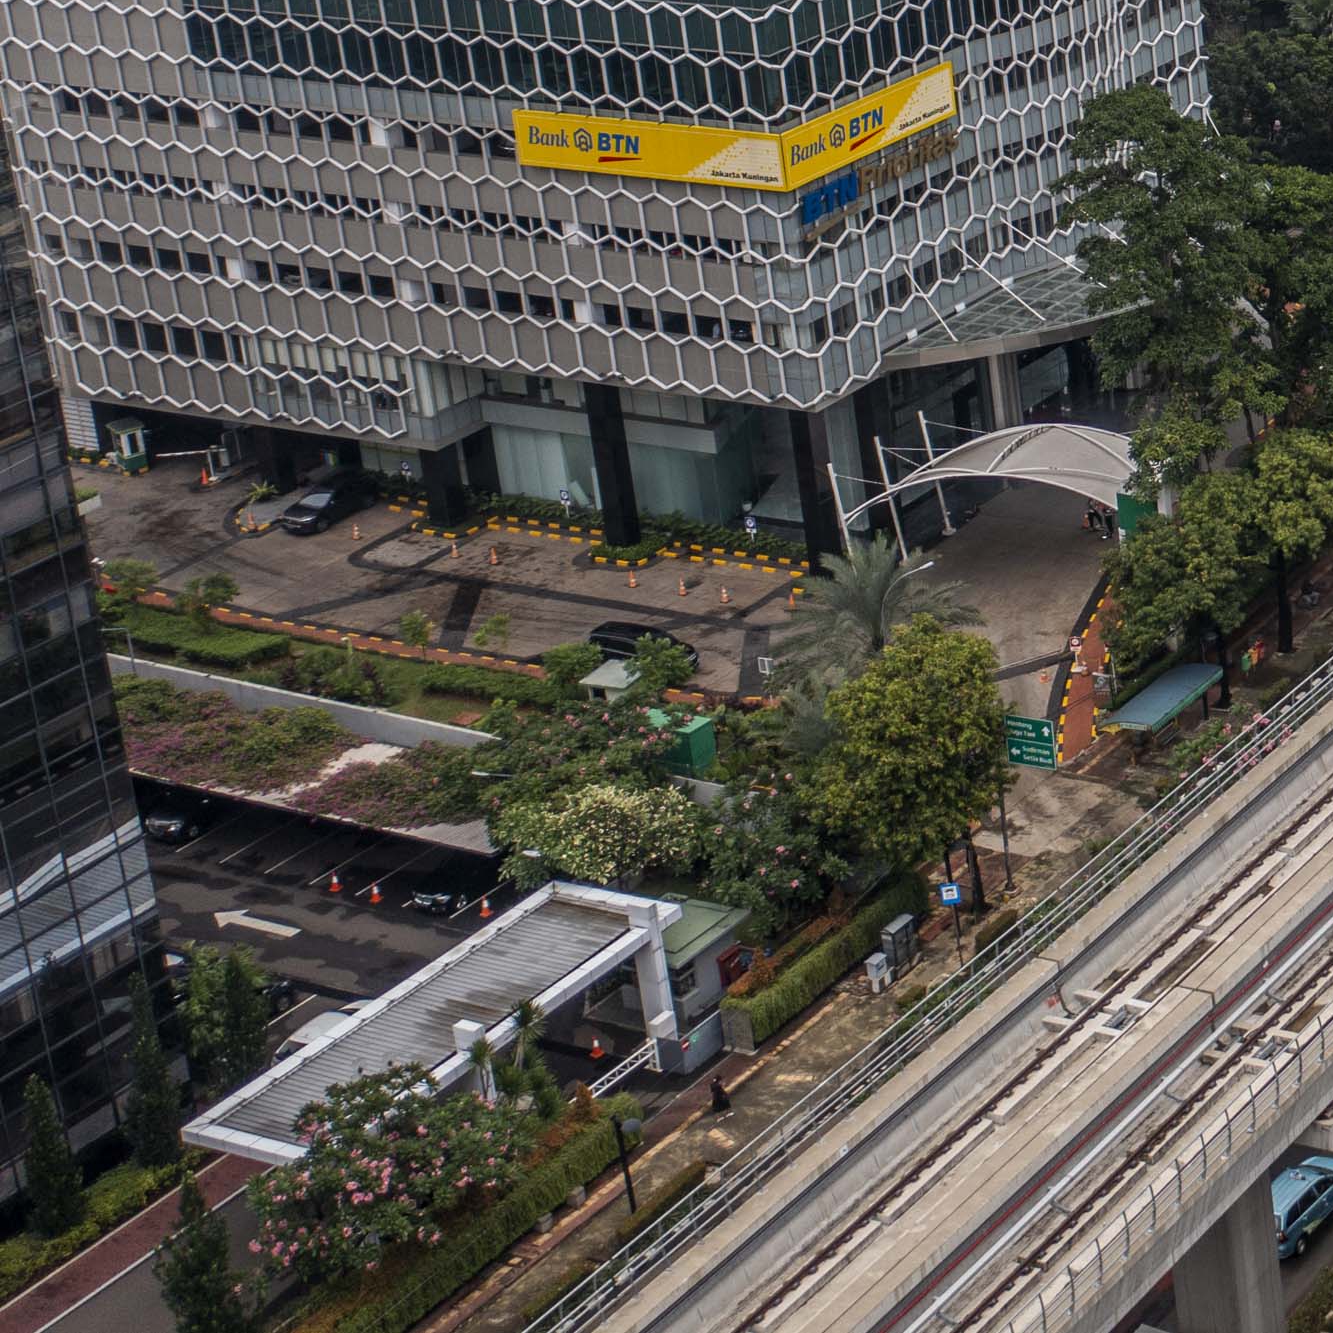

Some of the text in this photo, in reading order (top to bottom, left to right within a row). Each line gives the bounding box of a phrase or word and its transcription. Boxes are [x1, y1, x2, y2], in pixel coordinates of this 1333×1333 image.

[898, 103, 950, 131] Jakarta Kuningan
[528, 125, 639, 155] Bank BTN
[790, 106, 884, 166] Bank BTN
[711, 169, 779, 182] Jakarta Kuningan
[802, 134, 960, 226] BTN Prioritas
